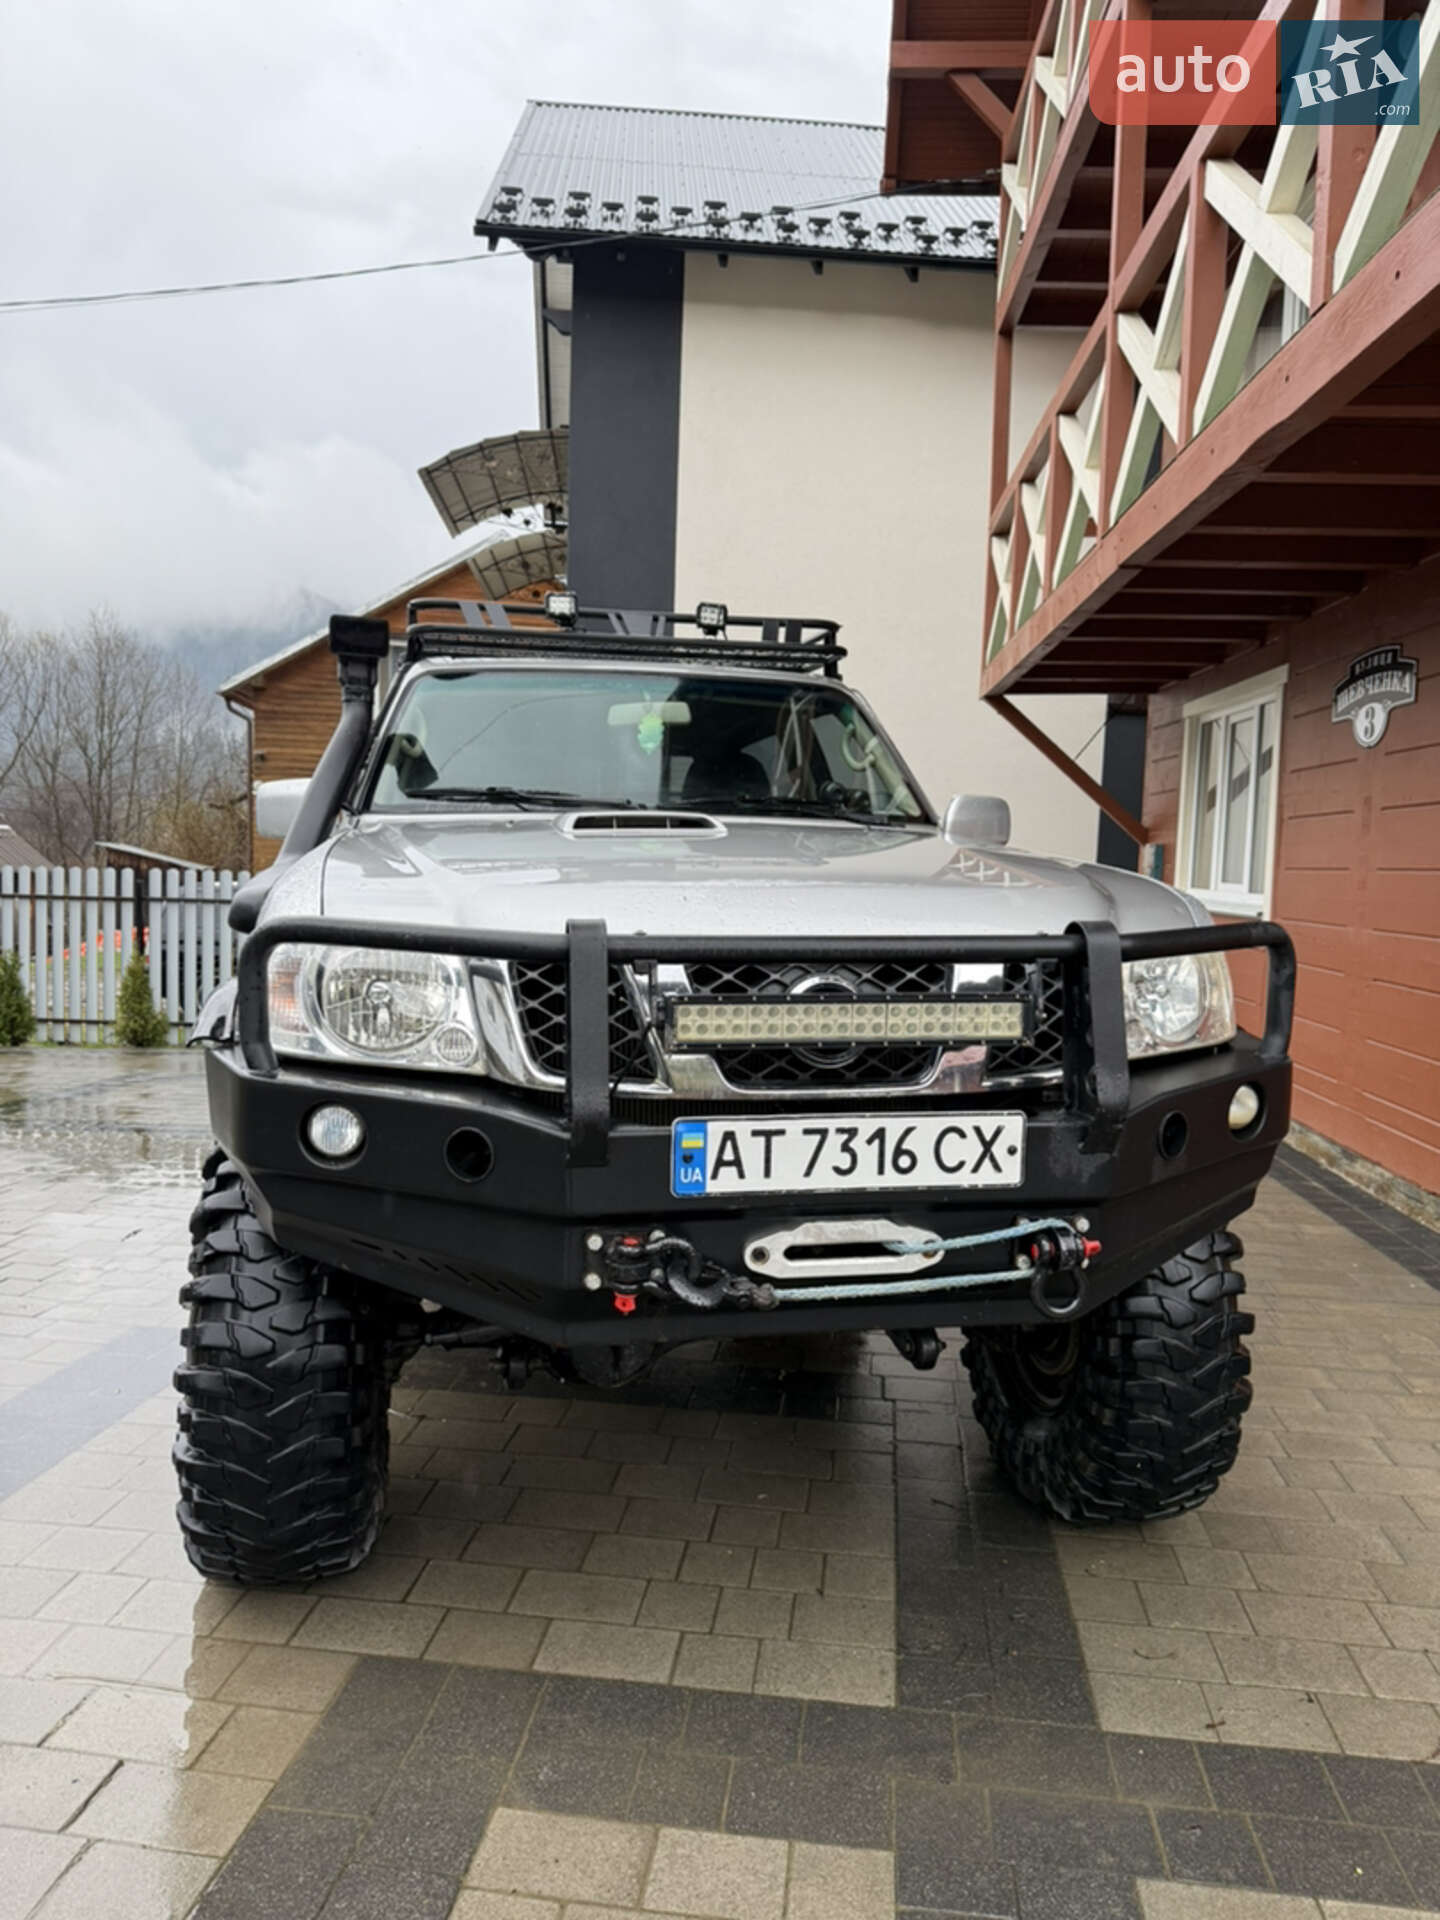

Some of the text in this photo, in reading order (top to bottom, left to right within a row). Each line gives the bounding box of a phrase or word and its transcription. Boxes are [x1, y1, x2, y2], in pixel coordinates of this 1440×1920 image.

[1364, 705, 1376, 739] 3
[710, 1125, 1005, 1181] AT 7316 CX
[679, 1167, 703, 1184] UA
